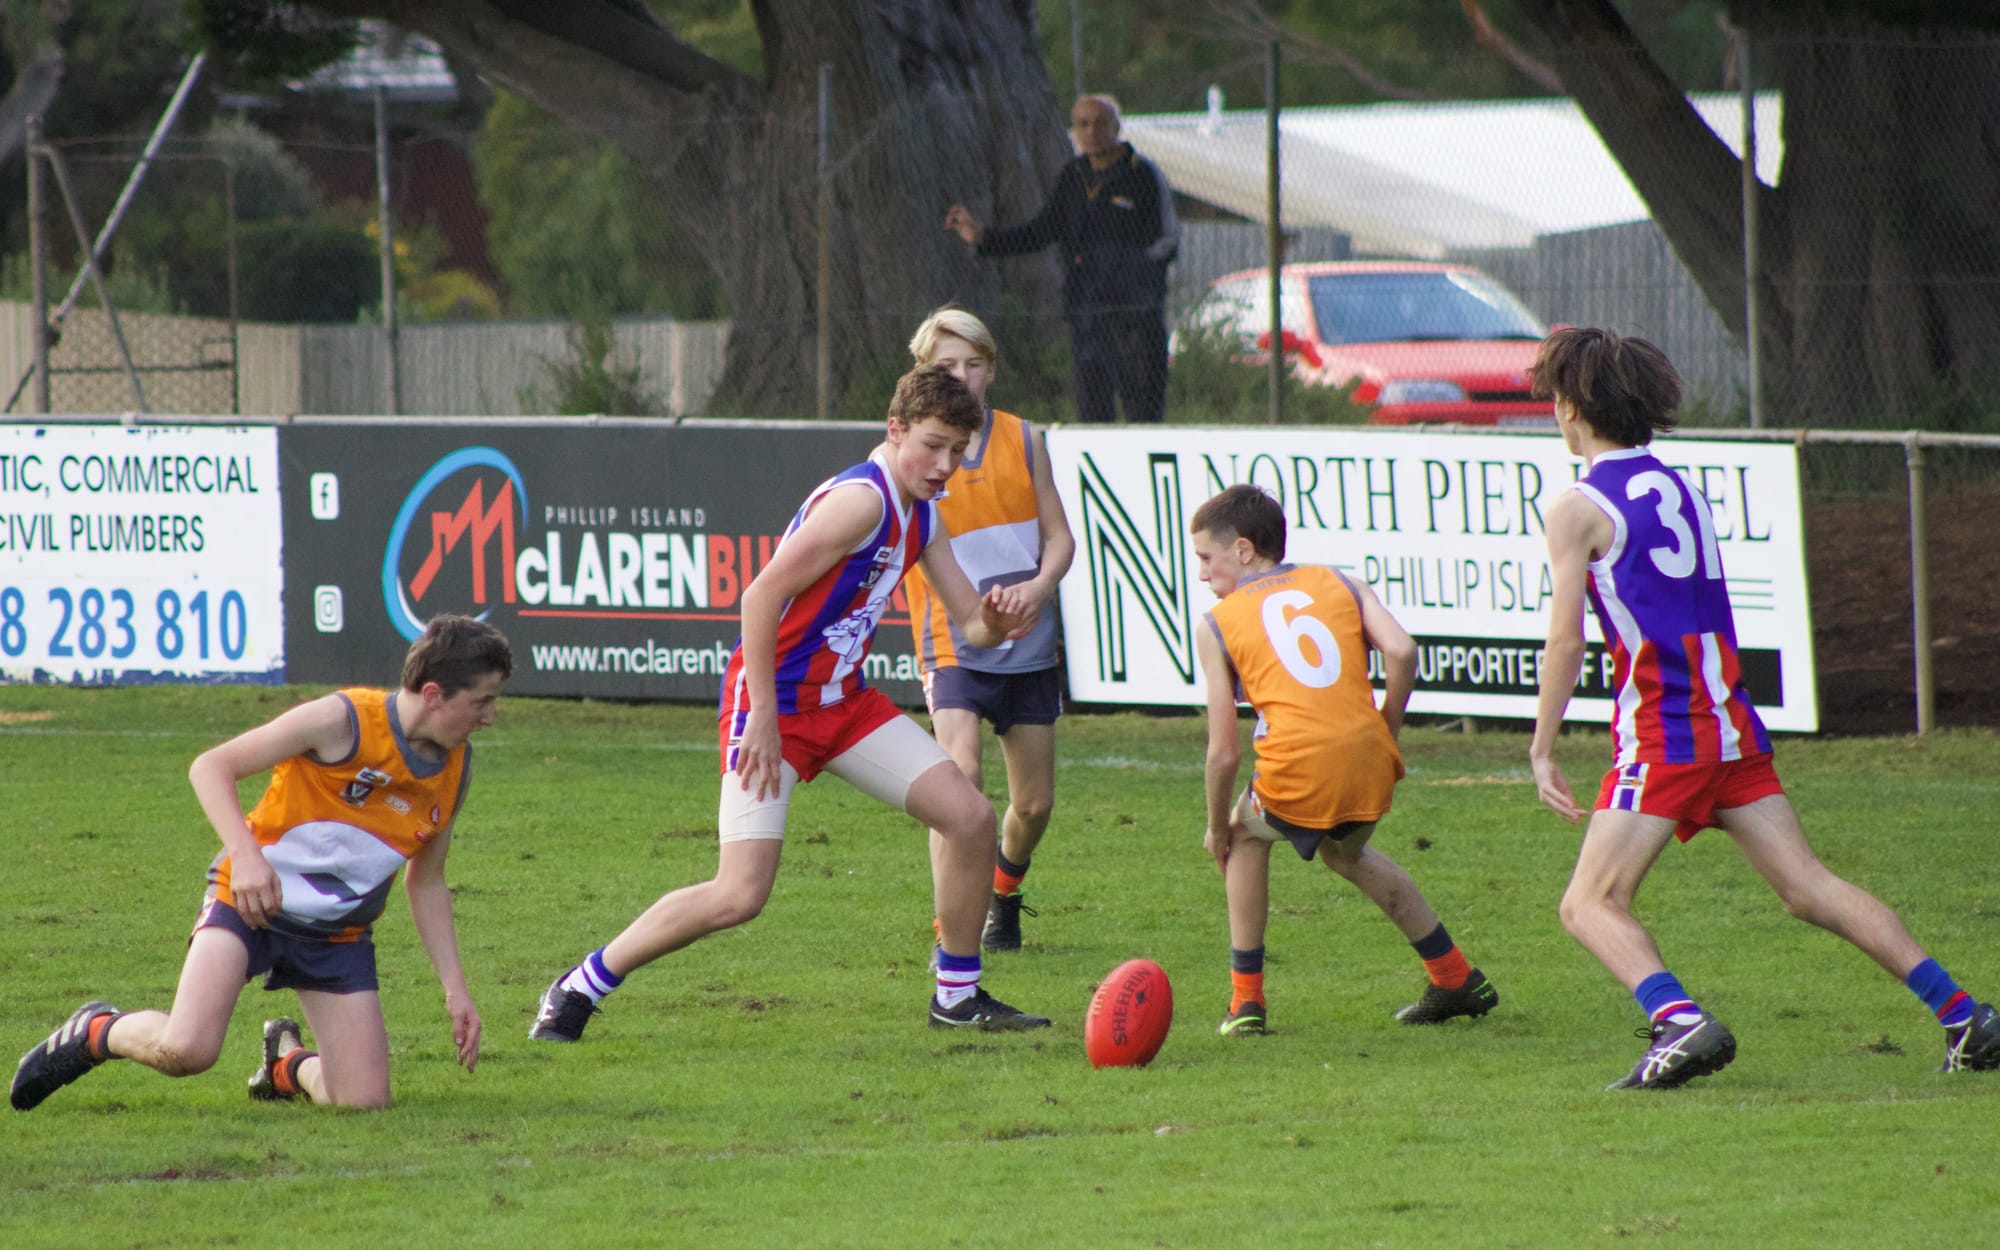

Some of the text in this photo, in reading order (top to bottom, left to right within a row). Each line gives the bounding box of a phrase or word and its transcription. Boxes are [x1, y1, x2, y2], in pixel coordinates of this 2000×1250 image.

[59, 455, 259, 493] COMMERCIAL
[1200, 453, 1402, 532] NORTH
[1421, 459, 1545, 536] PIER
[70, 514, 205, 552] PLUMBERS
[545, 506, 706, 528] PHILLIP ISLAND
[1626, 470, 1722, 579] 31
[1365, 555, 1479, 610] PHILLIP
[48, 587, 136, 658] 283
[156, 589, 247, 660] 810
[1261, 590, 1342, 688] 6
[532, 638, 731, 675] www.mclarenb
[1415, 645, 1545, 686] UPPORTE
[1575, 651, 1595, 688] F
[1111, 968, 1152, 1047] SHERRIN
